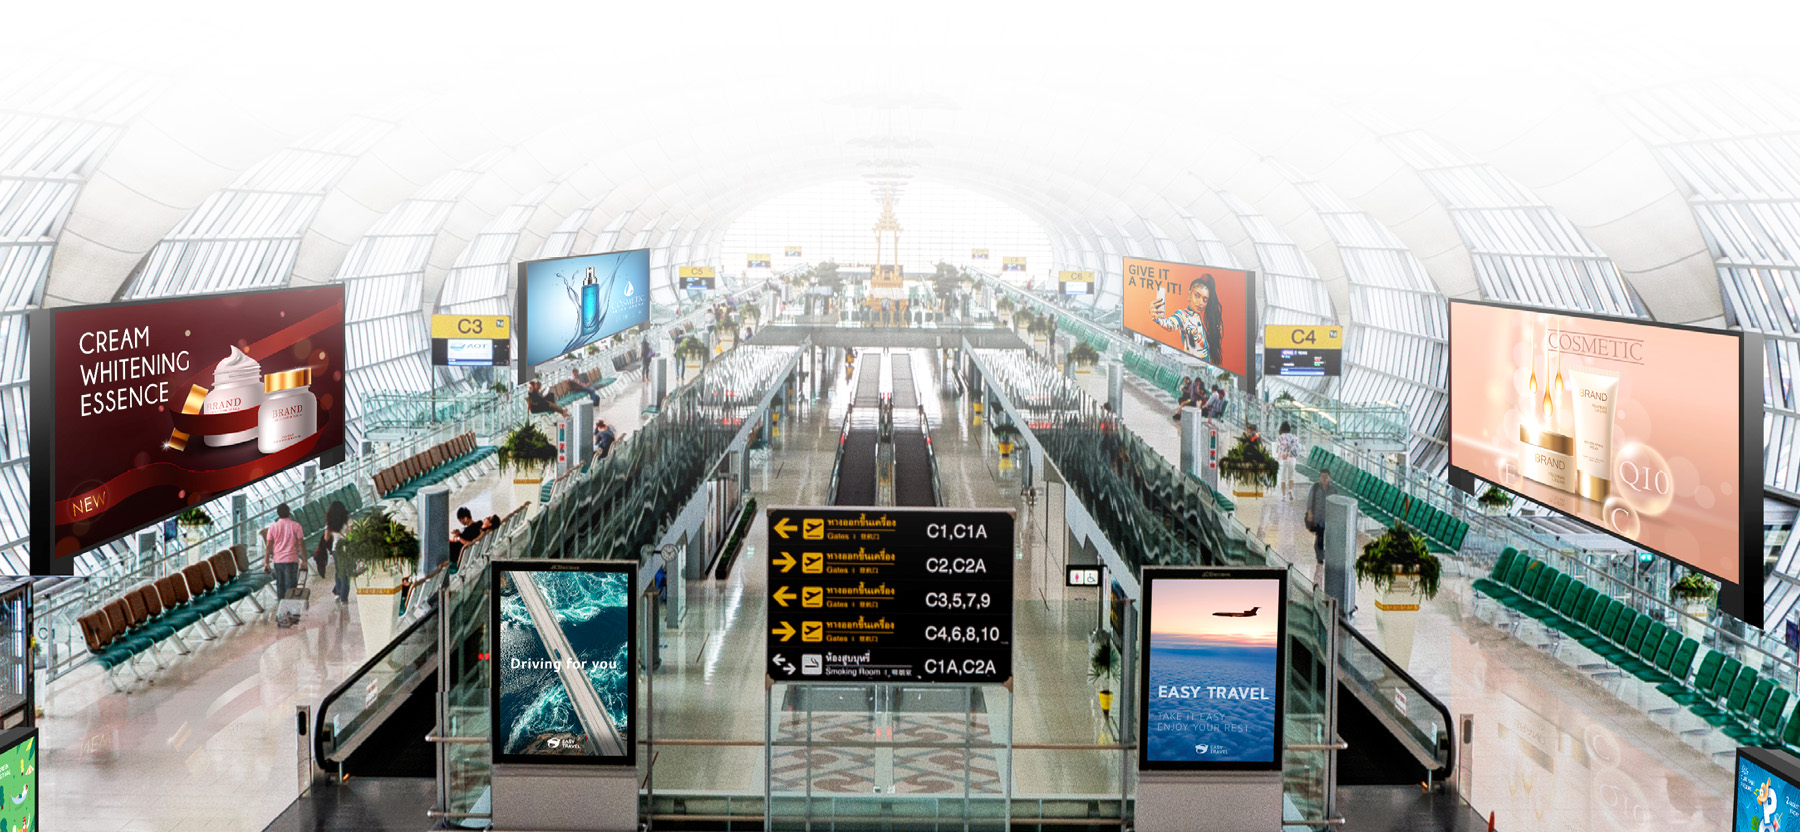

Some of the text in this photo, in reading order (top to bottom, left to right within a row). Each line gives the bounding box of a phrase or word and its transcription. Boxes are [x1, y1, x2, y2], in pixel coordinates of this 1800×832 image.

[691, 267, 703, 275] C5
[1070, 272, 1083, 280] C6
[1129, 264, 1170, 280] GIVE IT
[1128, 275, 1182, 295] A TRY IT!
[458, 318, 483, 334] C3
[79, 325, 149, 354] CREAM
[1291, 328, 1317, 345] C4
[1548, 332, 1643, 361] COSMETIC
[80, 350, 190, 386] WHITENING
[81, 381, 169, 417] ESSENCE
[1579, 388, 1608, 402] BRAND
[206, 397, 242, 411] BRAND
[272, 404, 303, 419] BRAND
[1534, 453, 1566, 470] BRAND
[1505, 463, 1517, 487] E
[1619, 460, 1670, 495] Q10
[72, 491, 106, 517] NEW
[1611, 507, 1629, 535] C
[926, 523, 988, 541] C1,C1A
[925, 557, 987, 575] C2,C2A
[925, 592, 991, 610] C3,5,7,9
[925, 625, 1000, 643] C4,6,8,10
[511, 658, 617, 673] Driving for you
[825, 667, 881, 677] Smoking Room
[924, 658, 997, 676] C1A,C2A
[1158, 685, 1269, 700] EASY TRAVEL
[1157, 712, 1182, 720] TAKE
[1186, 712, 1194, 720] IT
[1157, 722, 1252, 733] ENJOY YOUR REST.
